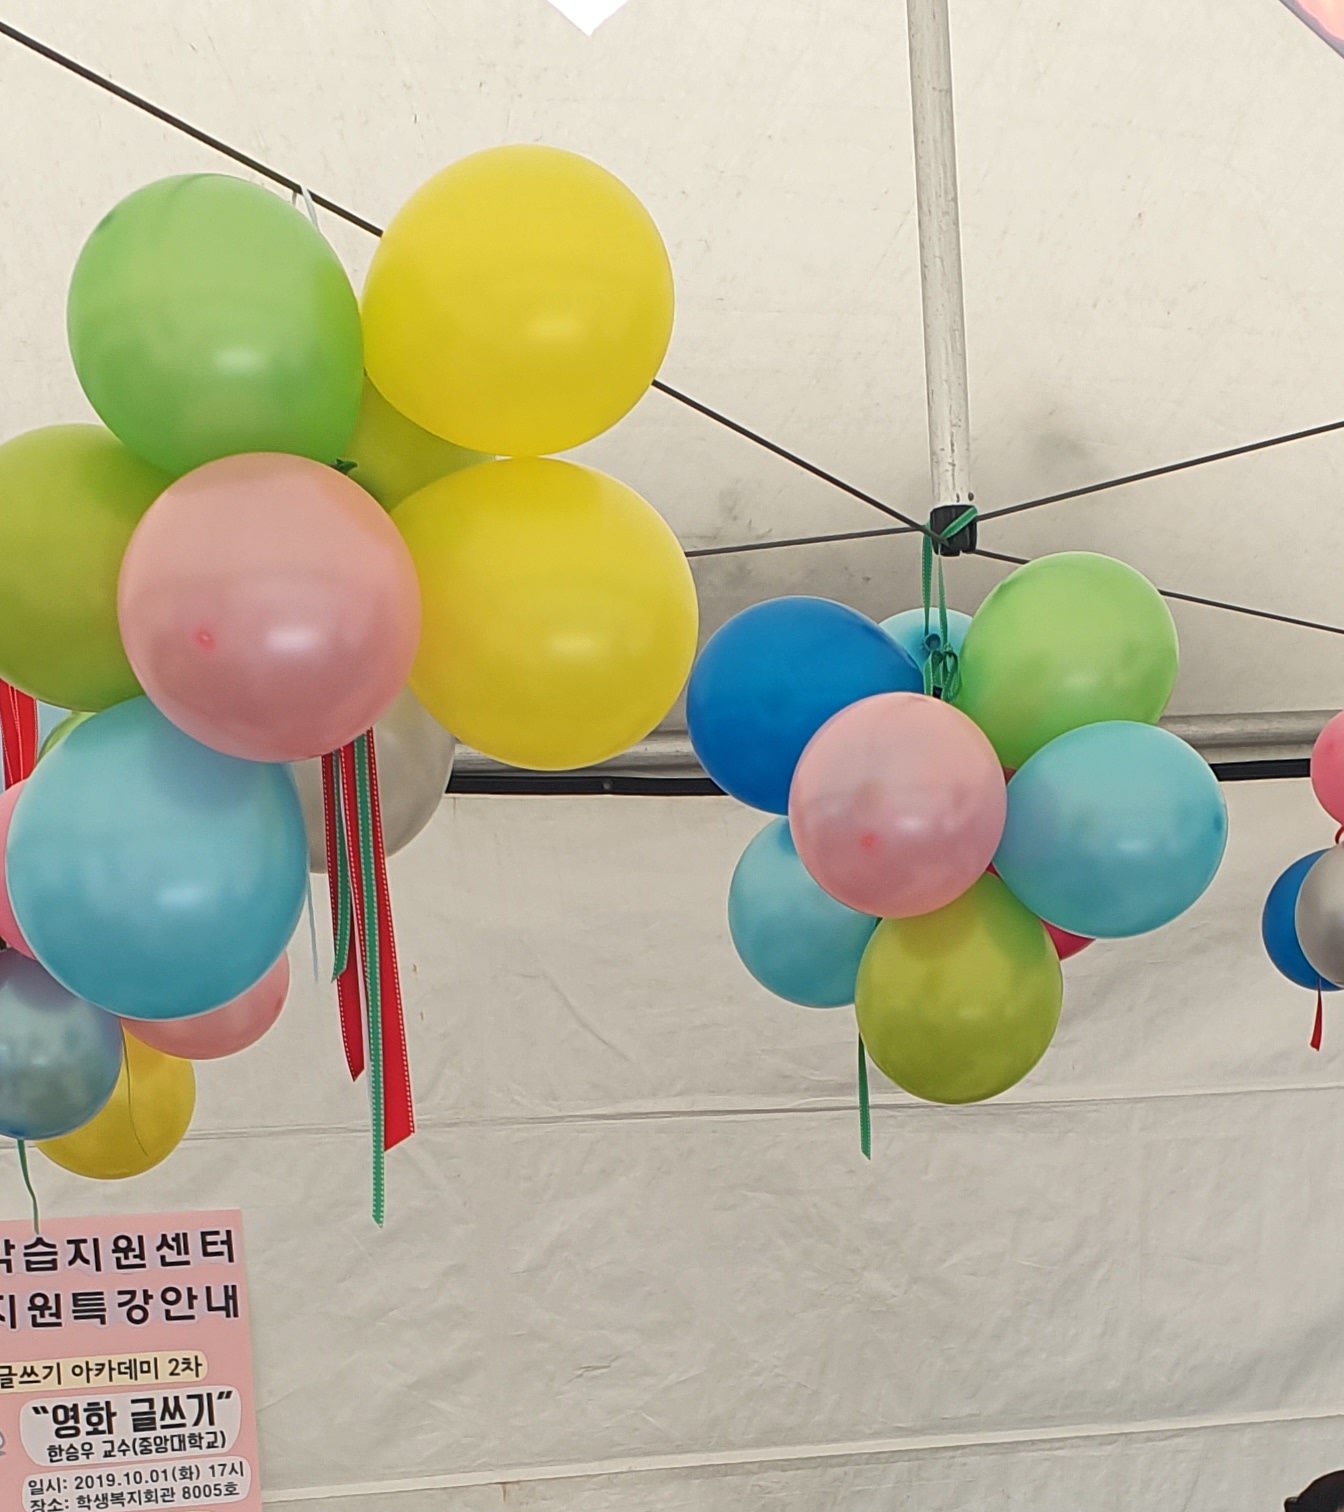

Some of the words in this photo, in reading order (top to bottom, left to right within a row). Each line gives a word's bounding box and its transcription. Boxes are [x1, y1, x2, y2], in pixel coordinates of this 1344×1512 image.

[72, 1357, 160, 1384] 아카데미
[168, 1355, 203, 1379] 2차
[46, 1442, 95, 1463] 한승우
[102, 1430, 226, 1459] 교수(중앙대학교)
[28, 1477, 68, 1496] 일시:
[74, 1464, 201, 1490] 2019.10.01(화)
[208, 1460, 245, 1479] 17시
[76, 1487, 176, 1511] 학생복지회관
[182, 1481, 240, 1500] 8005호
